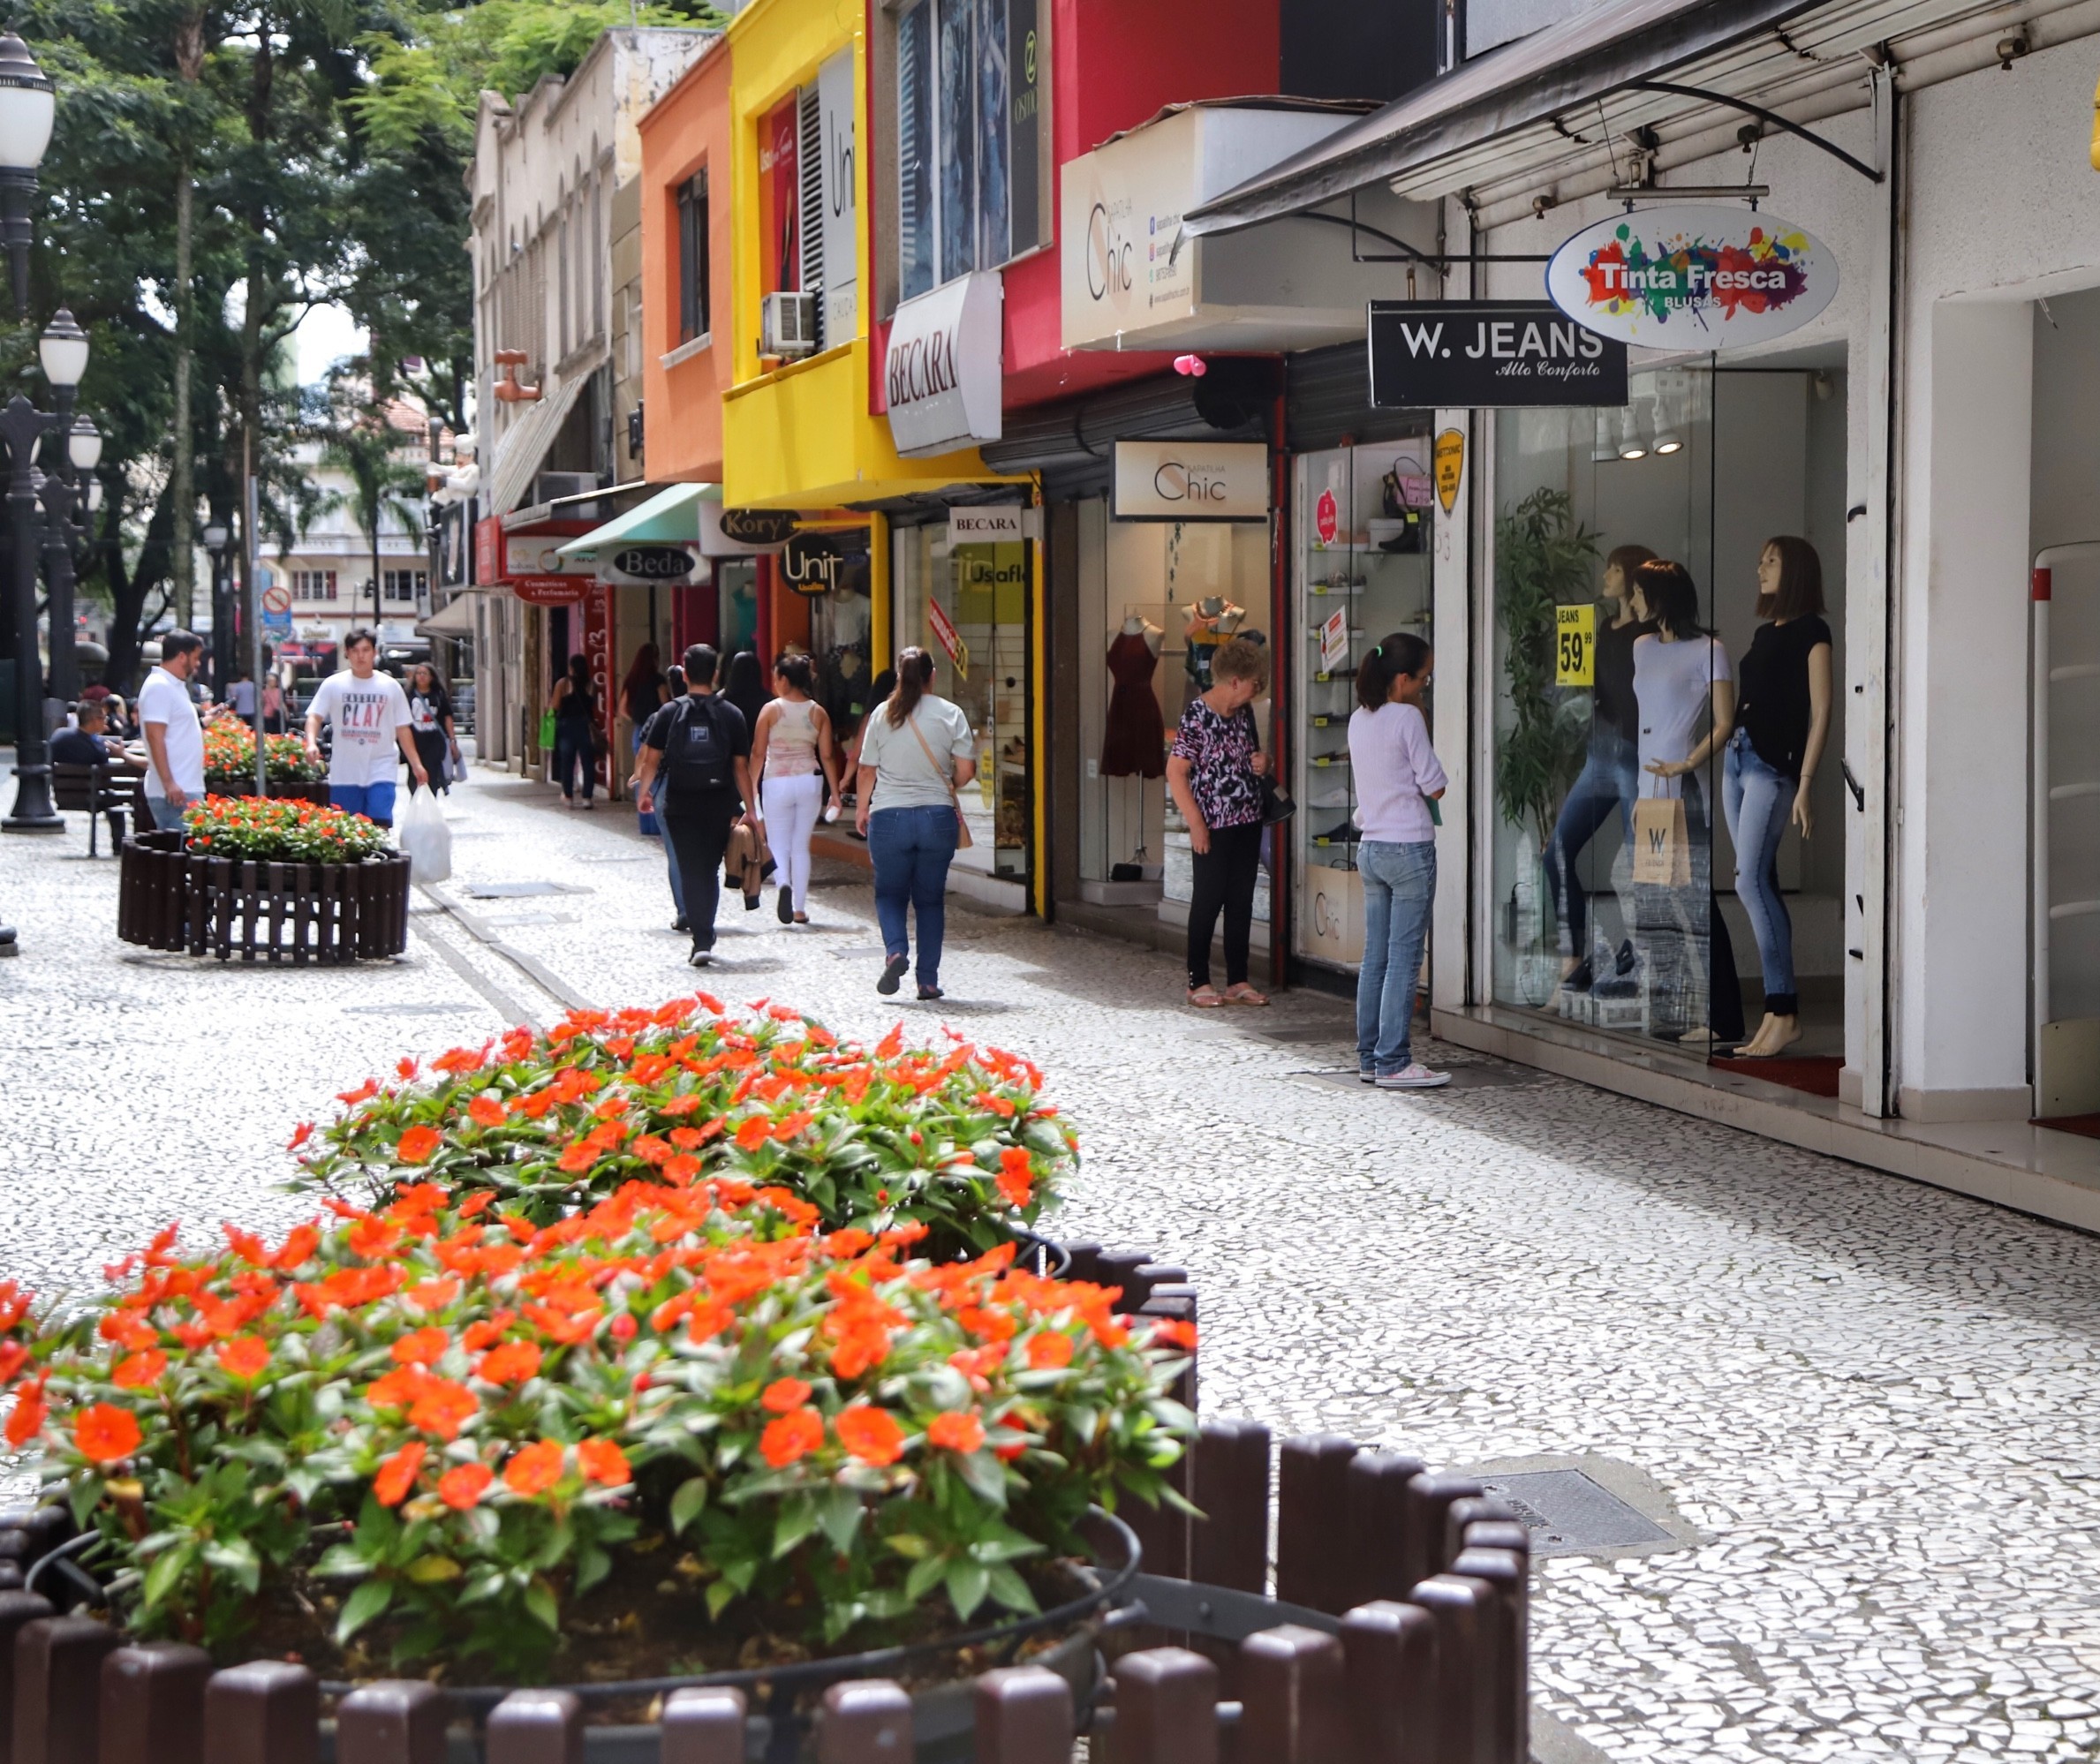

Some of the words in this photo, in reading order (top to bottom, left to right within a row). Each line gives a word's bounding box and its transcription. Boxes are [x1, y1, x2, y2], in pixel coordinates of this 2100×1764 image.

[1087, 202, 1132, 301] Chic
[1598, 262, 1676, 289] Tinta
[1688, 265, 1786, 290] Fresca
[1664, 297, 1721, 307] BLUSAS
[1400, 322, 1451, 359] W.
[1465, 321, 1604, 358] JEANS
[889, 324, 957, 407] BECARA
[1495, 361, 1531, 376] Alto
[1537, 361, 1600, 381] Conforto
[1154, 462, 1226, 501] Chic
[1187, 464, 1226, 473] SAPATILHA
[956, 517, 1017, 531] BECARA
[625, 551, 685, 574] Beda
[785, 543, 843, 590] Unit
[1558, 609, 1579, 623] JEANS
[342, 704, 385, 727] CLAY
[1649, 828, 1666, 855] W
[1315, 892, 1340, 940] Chic
